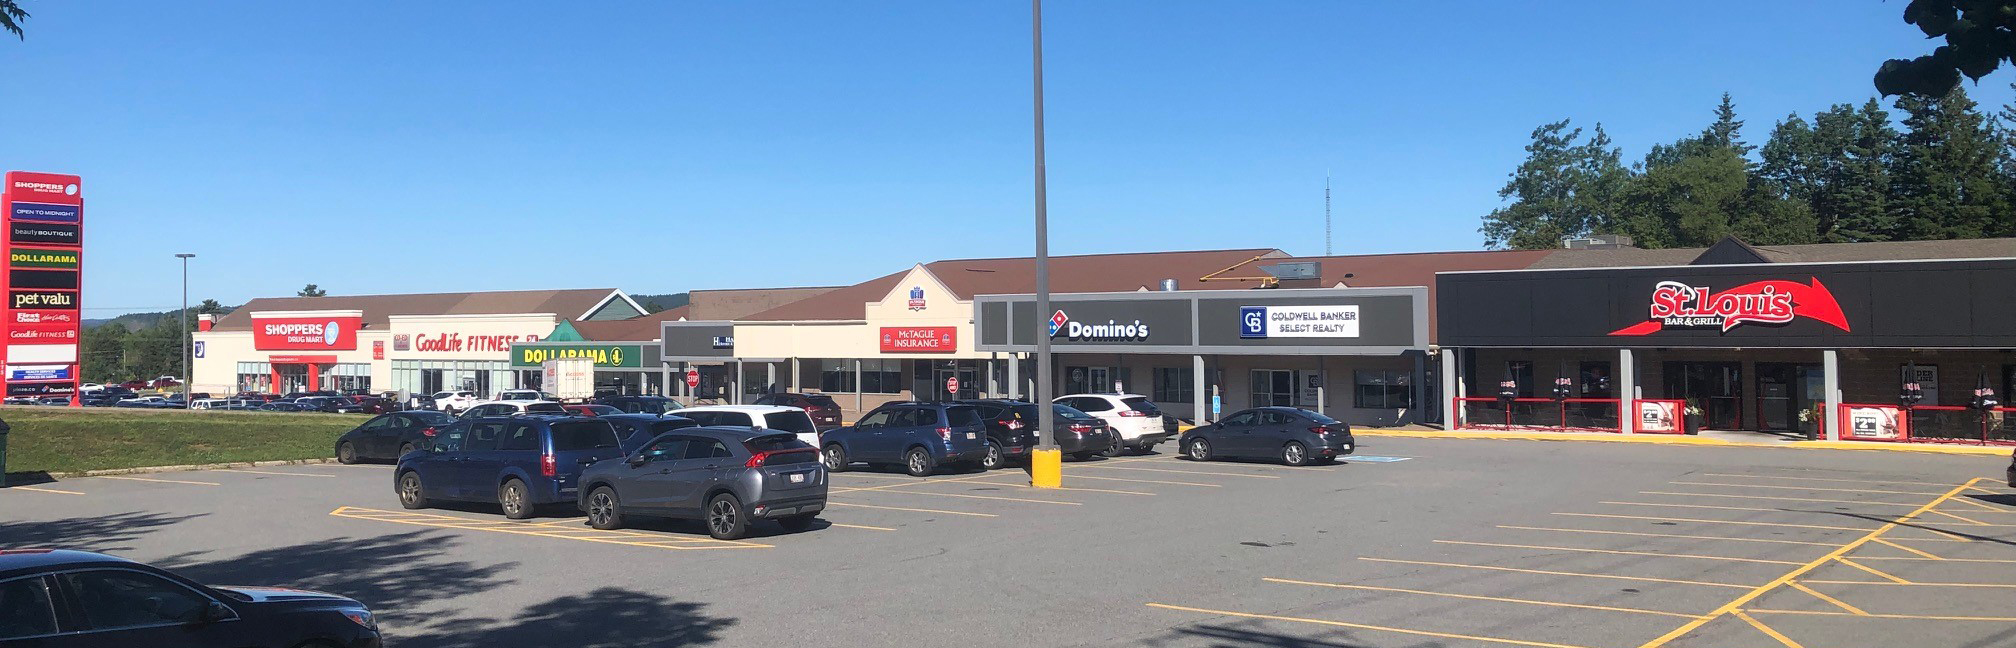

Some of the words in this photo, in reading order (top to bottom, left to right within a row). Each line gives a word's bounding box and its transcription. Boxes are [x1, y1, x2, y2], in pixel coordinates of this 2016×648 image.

[15, 181, 64, 190] SHOPPERS
[11, 254, 77, 263] DOLLARAMA
[15, 293, 39, 308] pet
[41, 292, 71, 305] valu
[1271, 311, 1318, 321] COLDWELL
[1320, 311, 1357, 321] BANKER
[1664, 317, 1684, 326] BAR
[265, 323, 323, 335] SHOPPERS
[1069, 319, 1148, 338] Domino's
[1279, 323, 1311, 333] SELECT
[1312, 323, 1345, 333] REALTY
[10, 330, 38, 338] GoodLife
[898, 329, 935, 339] McTAGUE
[415, 332, 463, 352] GoodLife
[894, 339, 939, 348] INSURANCE
[688, 375, 699, 383] STOP
